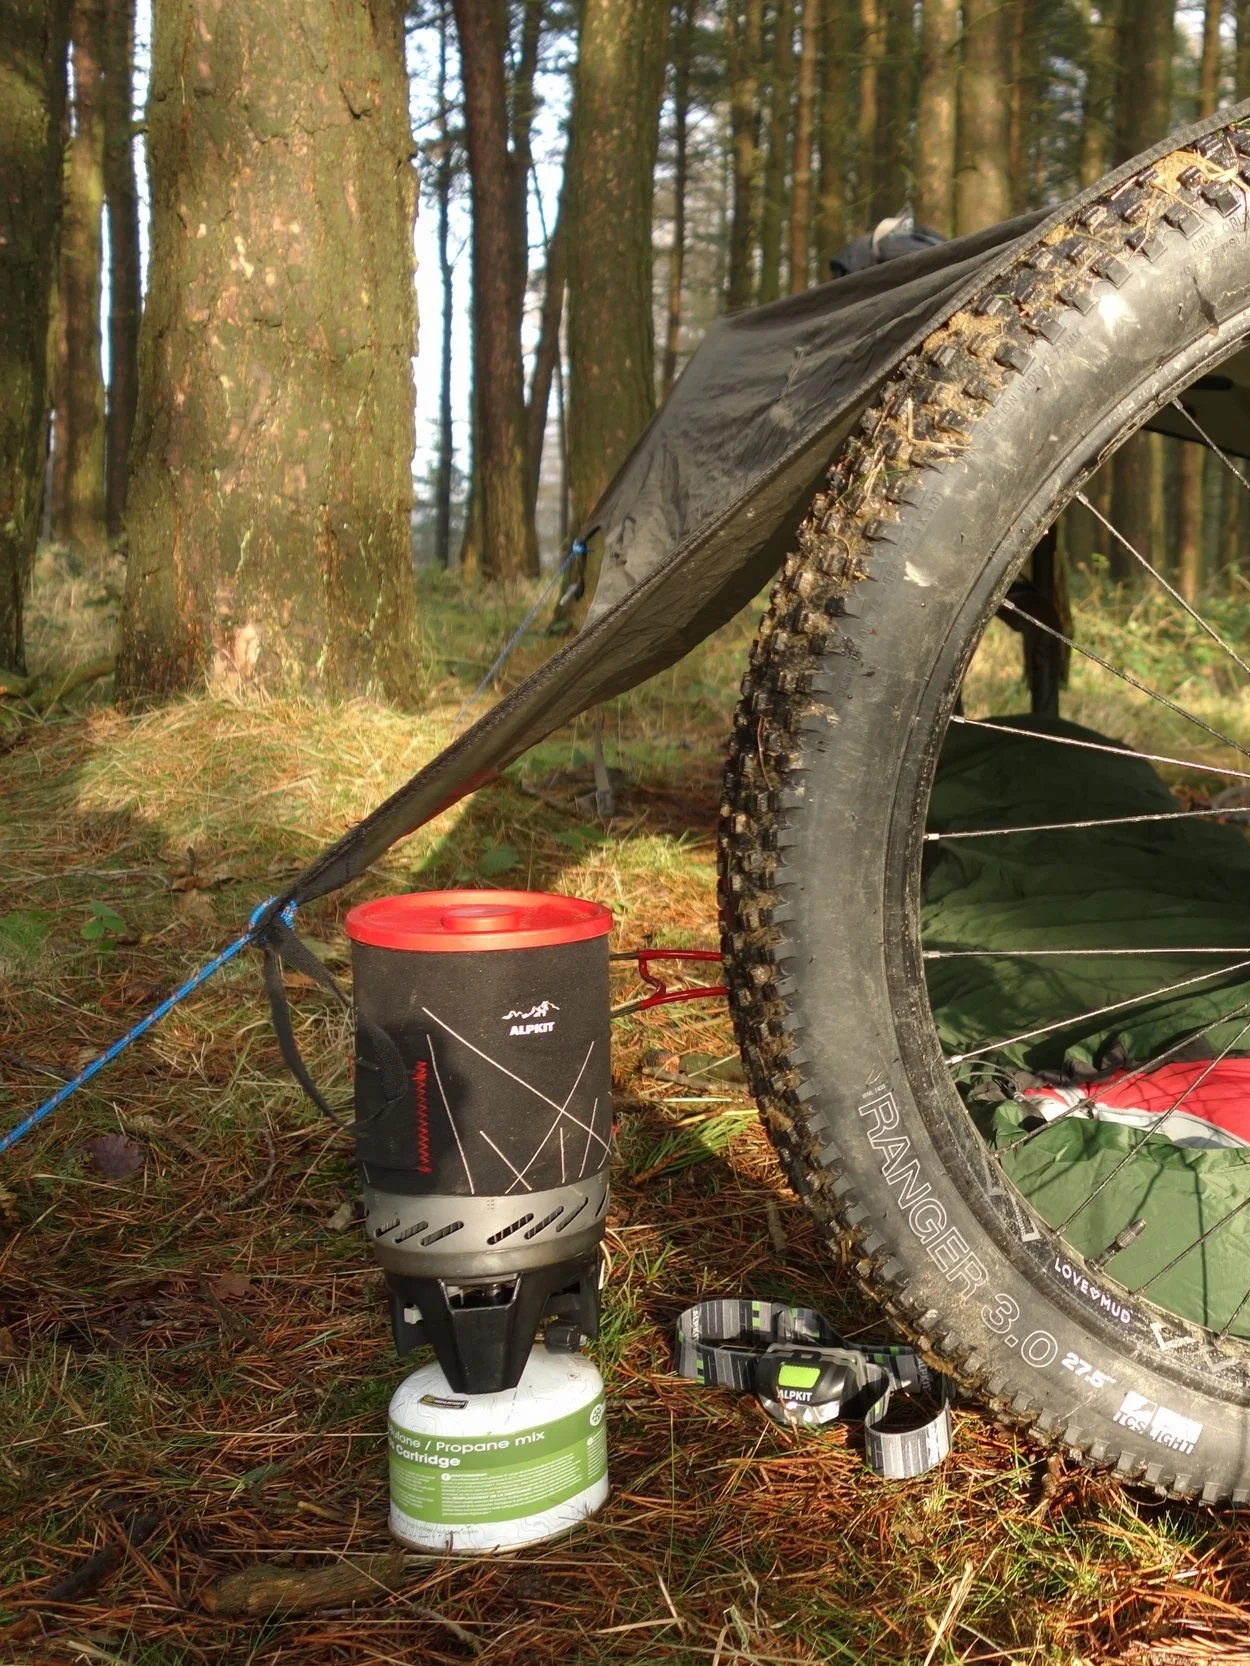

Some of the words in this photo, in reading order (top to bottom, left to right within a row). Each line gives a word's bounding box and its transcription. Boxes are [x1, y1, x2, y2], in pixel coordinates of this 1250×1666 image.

[975, 392, 1020, 441] SECTION
[509, 1021, 556, 1036] ALPKIT
[858, 1091, 990, 1301] RANGER
[980, 1292, 1058, 1368] 3.0
[1054, 1256, 1090, 1295] LOVE
[1100, 1294, 1132, 1324] MUD
[776, 1388, 813, 1402] ALPKIT
[1113, 1409, 1148, 1436] TCS
[436, 1440, 510, 1454] Propane
[515, 1431, 545, 1447] mix
[396, 1445, 461, 1469] Cartridge
